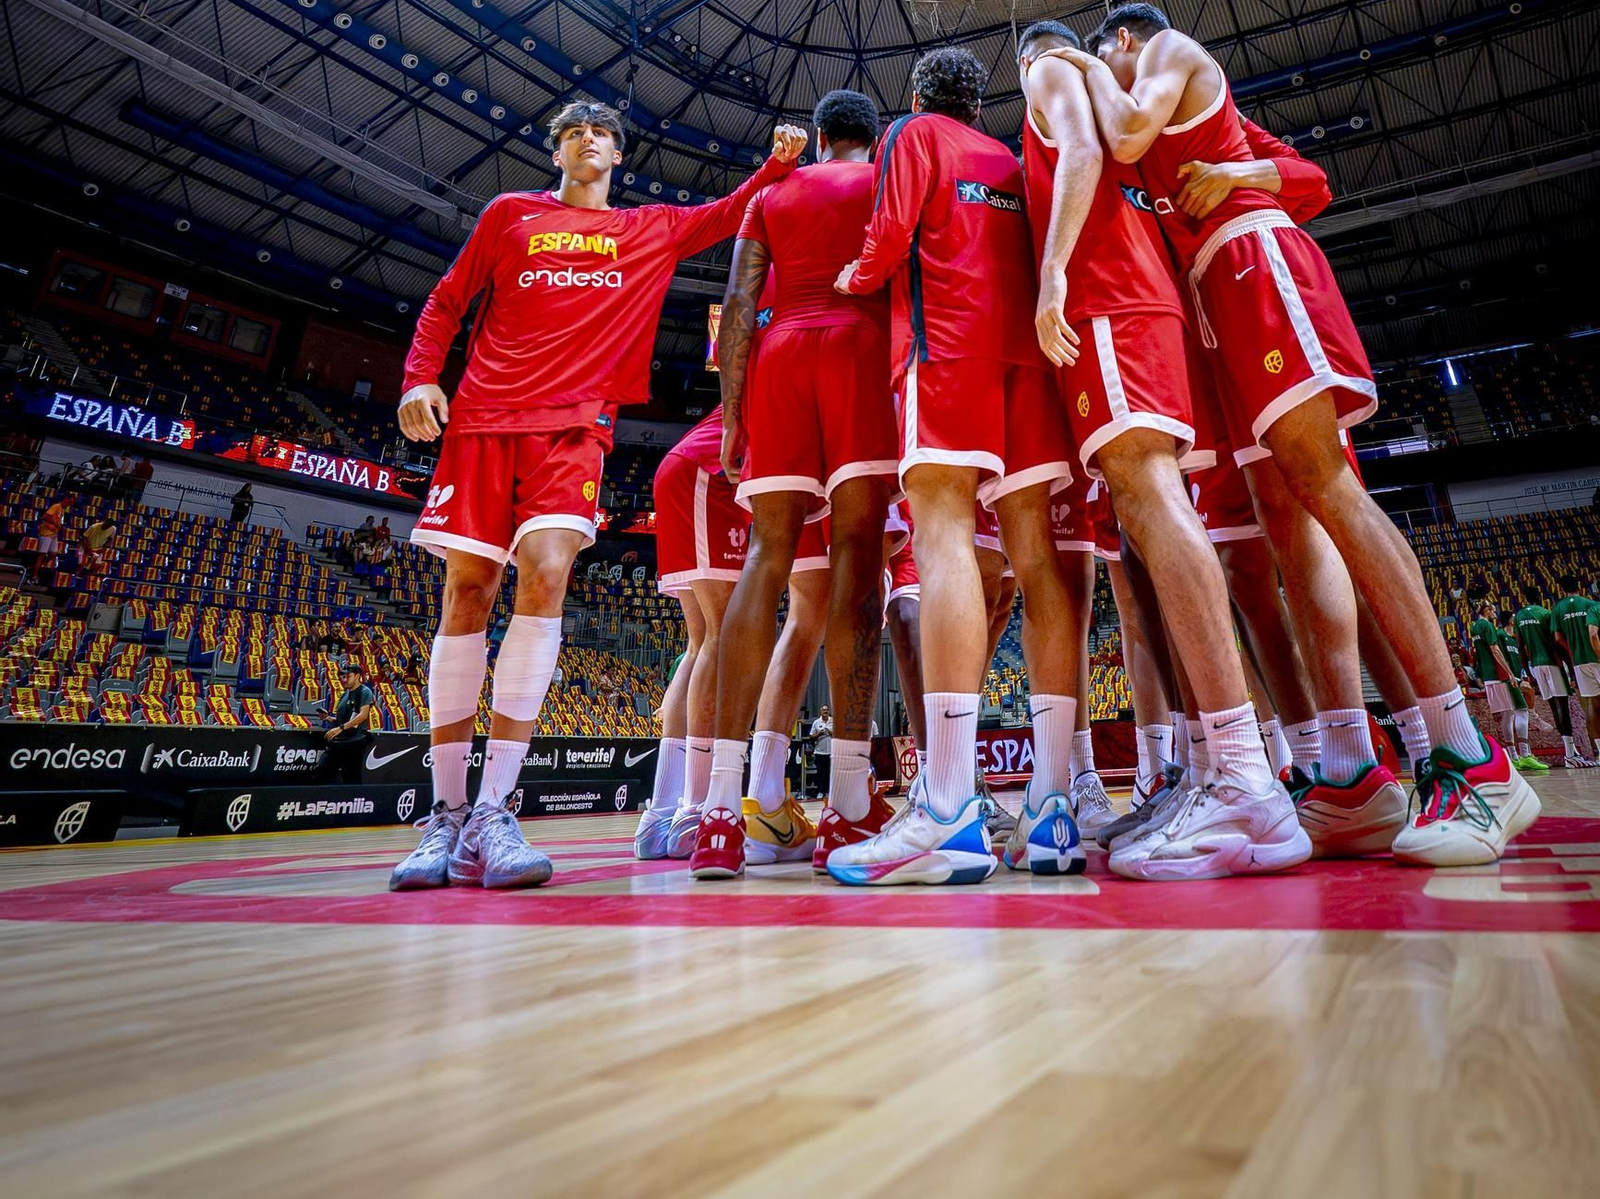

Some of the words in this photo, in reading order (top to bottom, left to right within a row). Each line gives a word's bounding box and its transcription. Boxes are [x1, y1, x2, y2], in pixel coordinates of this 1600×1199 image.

[980, 185, 1021, 211] Caixa
[518, 266, 622, 288] endesa
[46, 392, 160, 442] ESPAÑA
[164, 421, 185, 447] B
[289, 451, 370, 489] ESPAÑA
[375, 470, 390, 492] B
[10, 743, 126, 769] endesa
[177, 749, 251, 768] CaixaBank
[276, 797, 374, 821] #LaFamilia
[539, 793, 571, 803] SELECCIÓN
[571, 791, 602, 801] ESPAÑOLA
[555, 802, 593, 811] BALONCESTO
